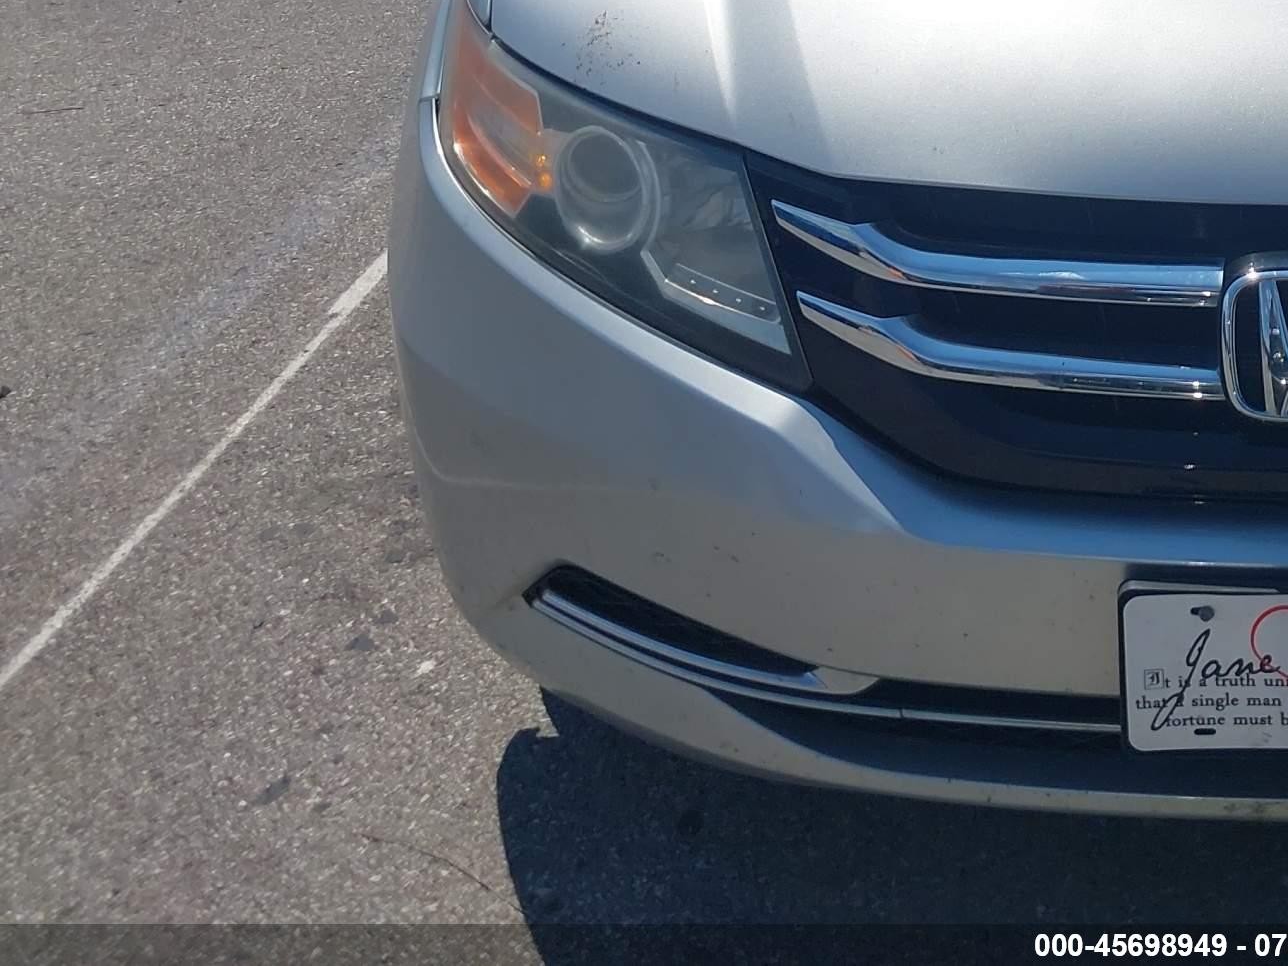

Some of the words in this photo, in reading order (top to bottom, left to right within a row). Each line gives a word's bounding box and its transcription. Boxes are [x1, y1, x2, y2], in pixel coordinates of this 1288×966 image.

[1151, 628, 1281, 731] Jane
[1199, 677, 1207, 687] a
[1215, 673, 1256, 687] truth
[1136, 695, 1168, 710] that
[1191, 692, 1239, 712] single
[1246, 696, 1282, 707] man
[1165, 714, 1226, 727] fortune
[1233, 714, 1272, 726] must
